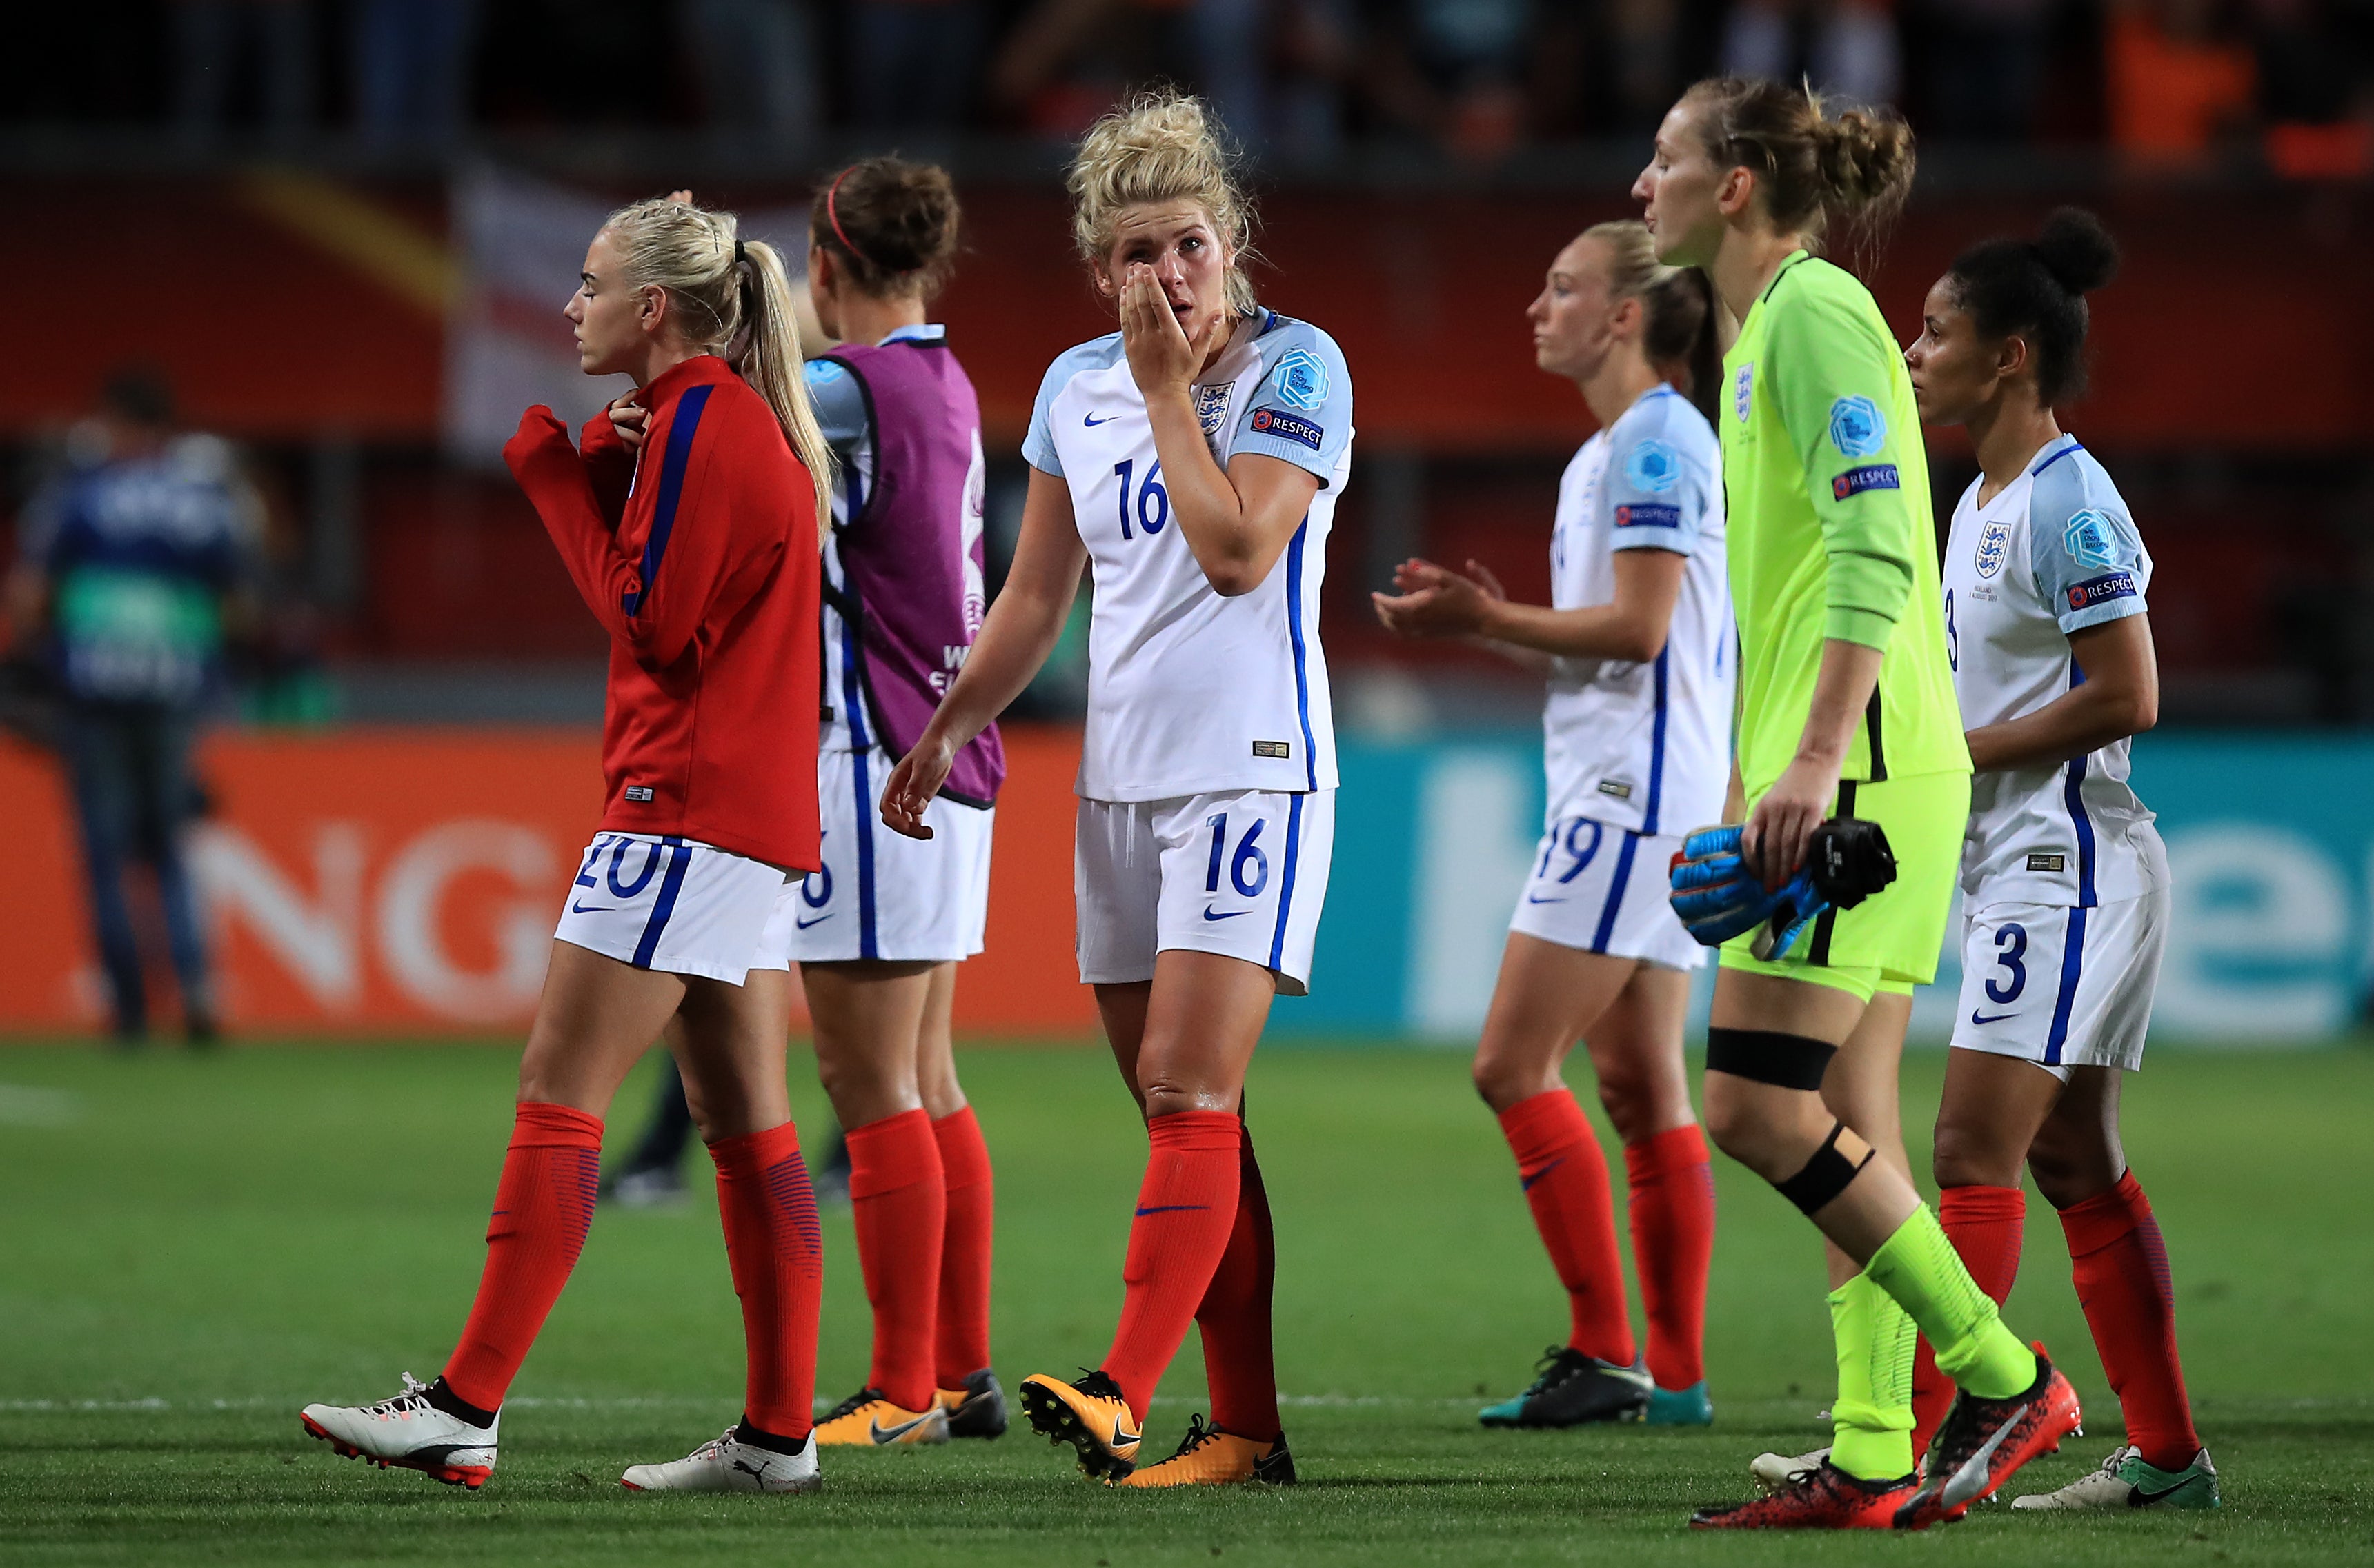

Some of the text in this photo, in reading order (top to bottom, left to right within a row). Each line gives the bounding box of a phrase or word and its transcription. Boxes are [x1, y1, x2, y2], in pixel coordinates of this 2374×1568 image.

[1272, 417, 1322, 444] RESPECT
[1114, 458, 1169, 540] 16
[1850, 469, 1897, 488] RESPECT
[2088, 578, 2134, 599] RESPECT
[1205, 812, 1269, 897] 16
[1985, 922, 2028, 1004] 3
